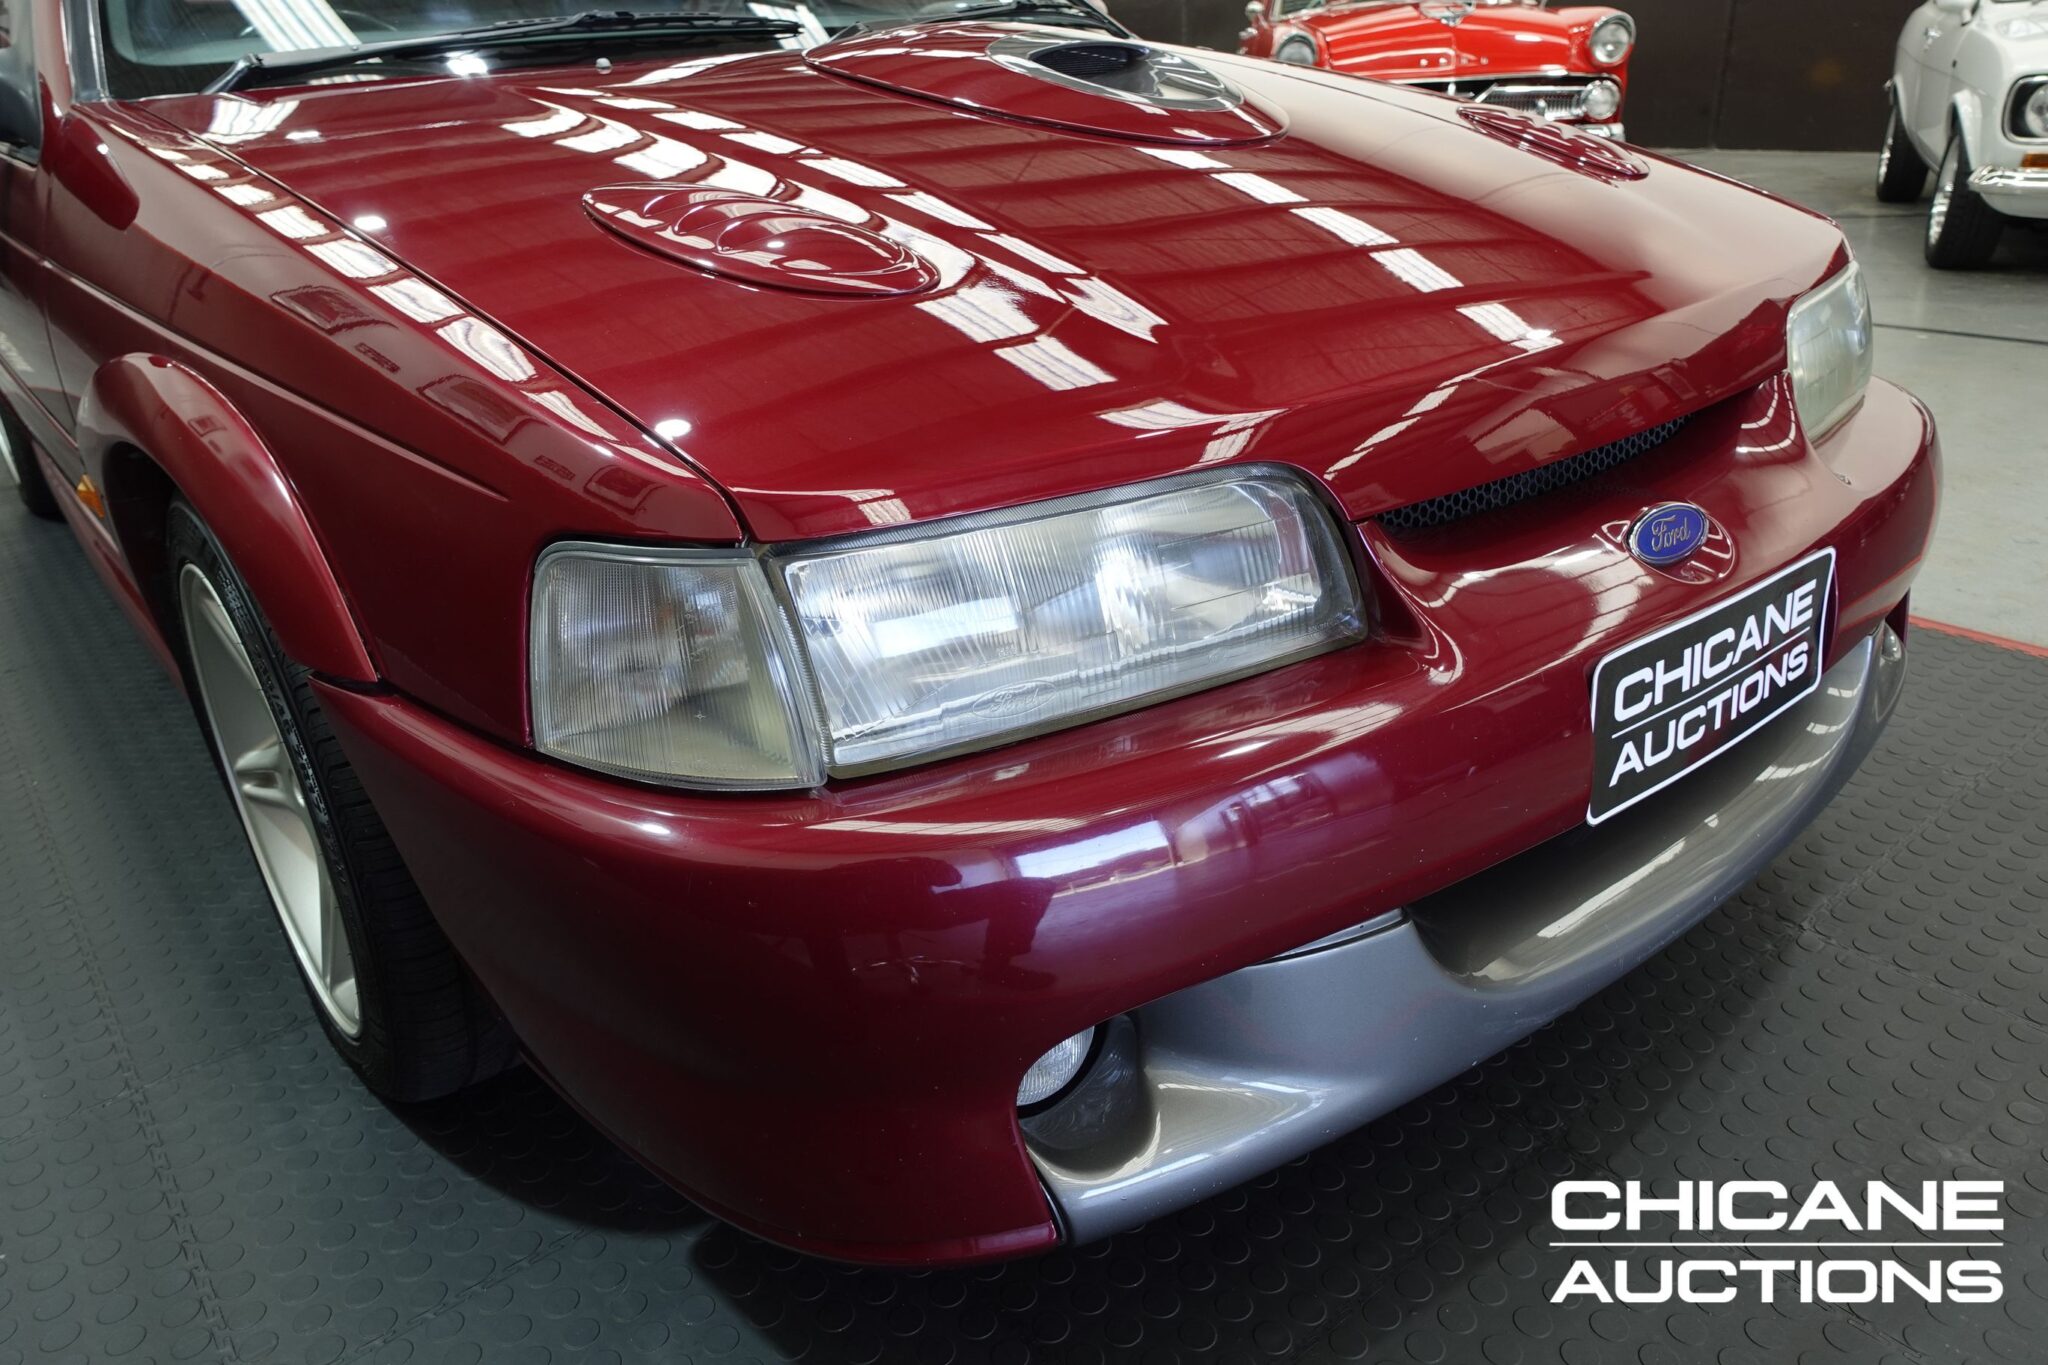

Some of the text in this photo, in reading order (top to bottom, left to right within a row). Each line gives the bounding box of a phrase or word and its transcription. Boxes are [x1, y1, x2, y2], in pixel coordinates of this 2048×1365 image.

[1652, 514, 1691, 552] Ford
[1609, 641, 1809, 788] AUCTIONS
[1614, 578, 1817, 722] CHICANE
